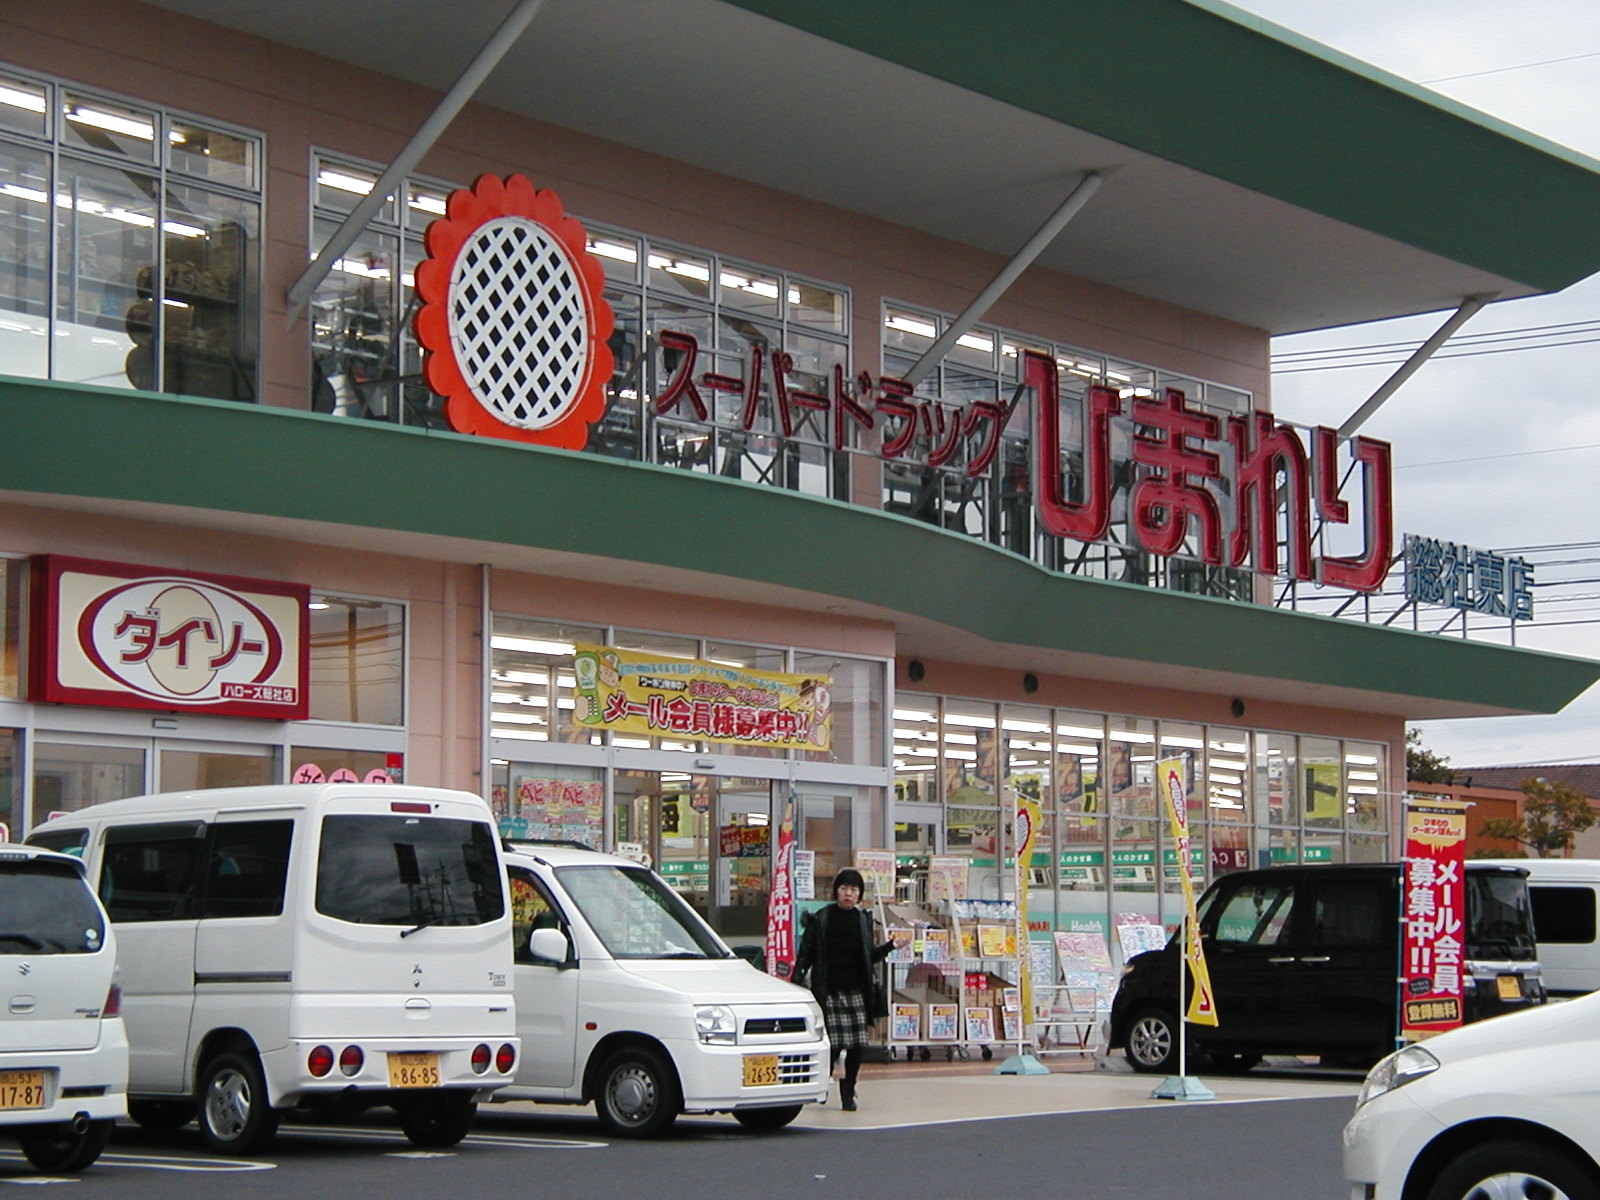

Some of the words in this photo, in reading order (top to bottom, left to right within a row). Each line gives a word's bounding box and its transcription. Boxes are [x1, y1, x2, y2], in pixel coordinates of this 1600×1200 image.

[656, 329, 1008, 478] スーパードラッグ
[1022, 348, 1392, 594] ひまわり
[1404, 535, 1535, 621] 総社東店
[114, 607, 265, 672] ダイソー
[223, 684, 294, 703] ハローズ総社店
[603, 690, 811, 744] メール会員様募集中!!
[1407, 857, 1436, 974] 募集中!!
[1434, 859, 1461, 995] メール会員
[401, 1067, 438, 1084] 86-85
[752, 1066, 777, 1083] 26-55
